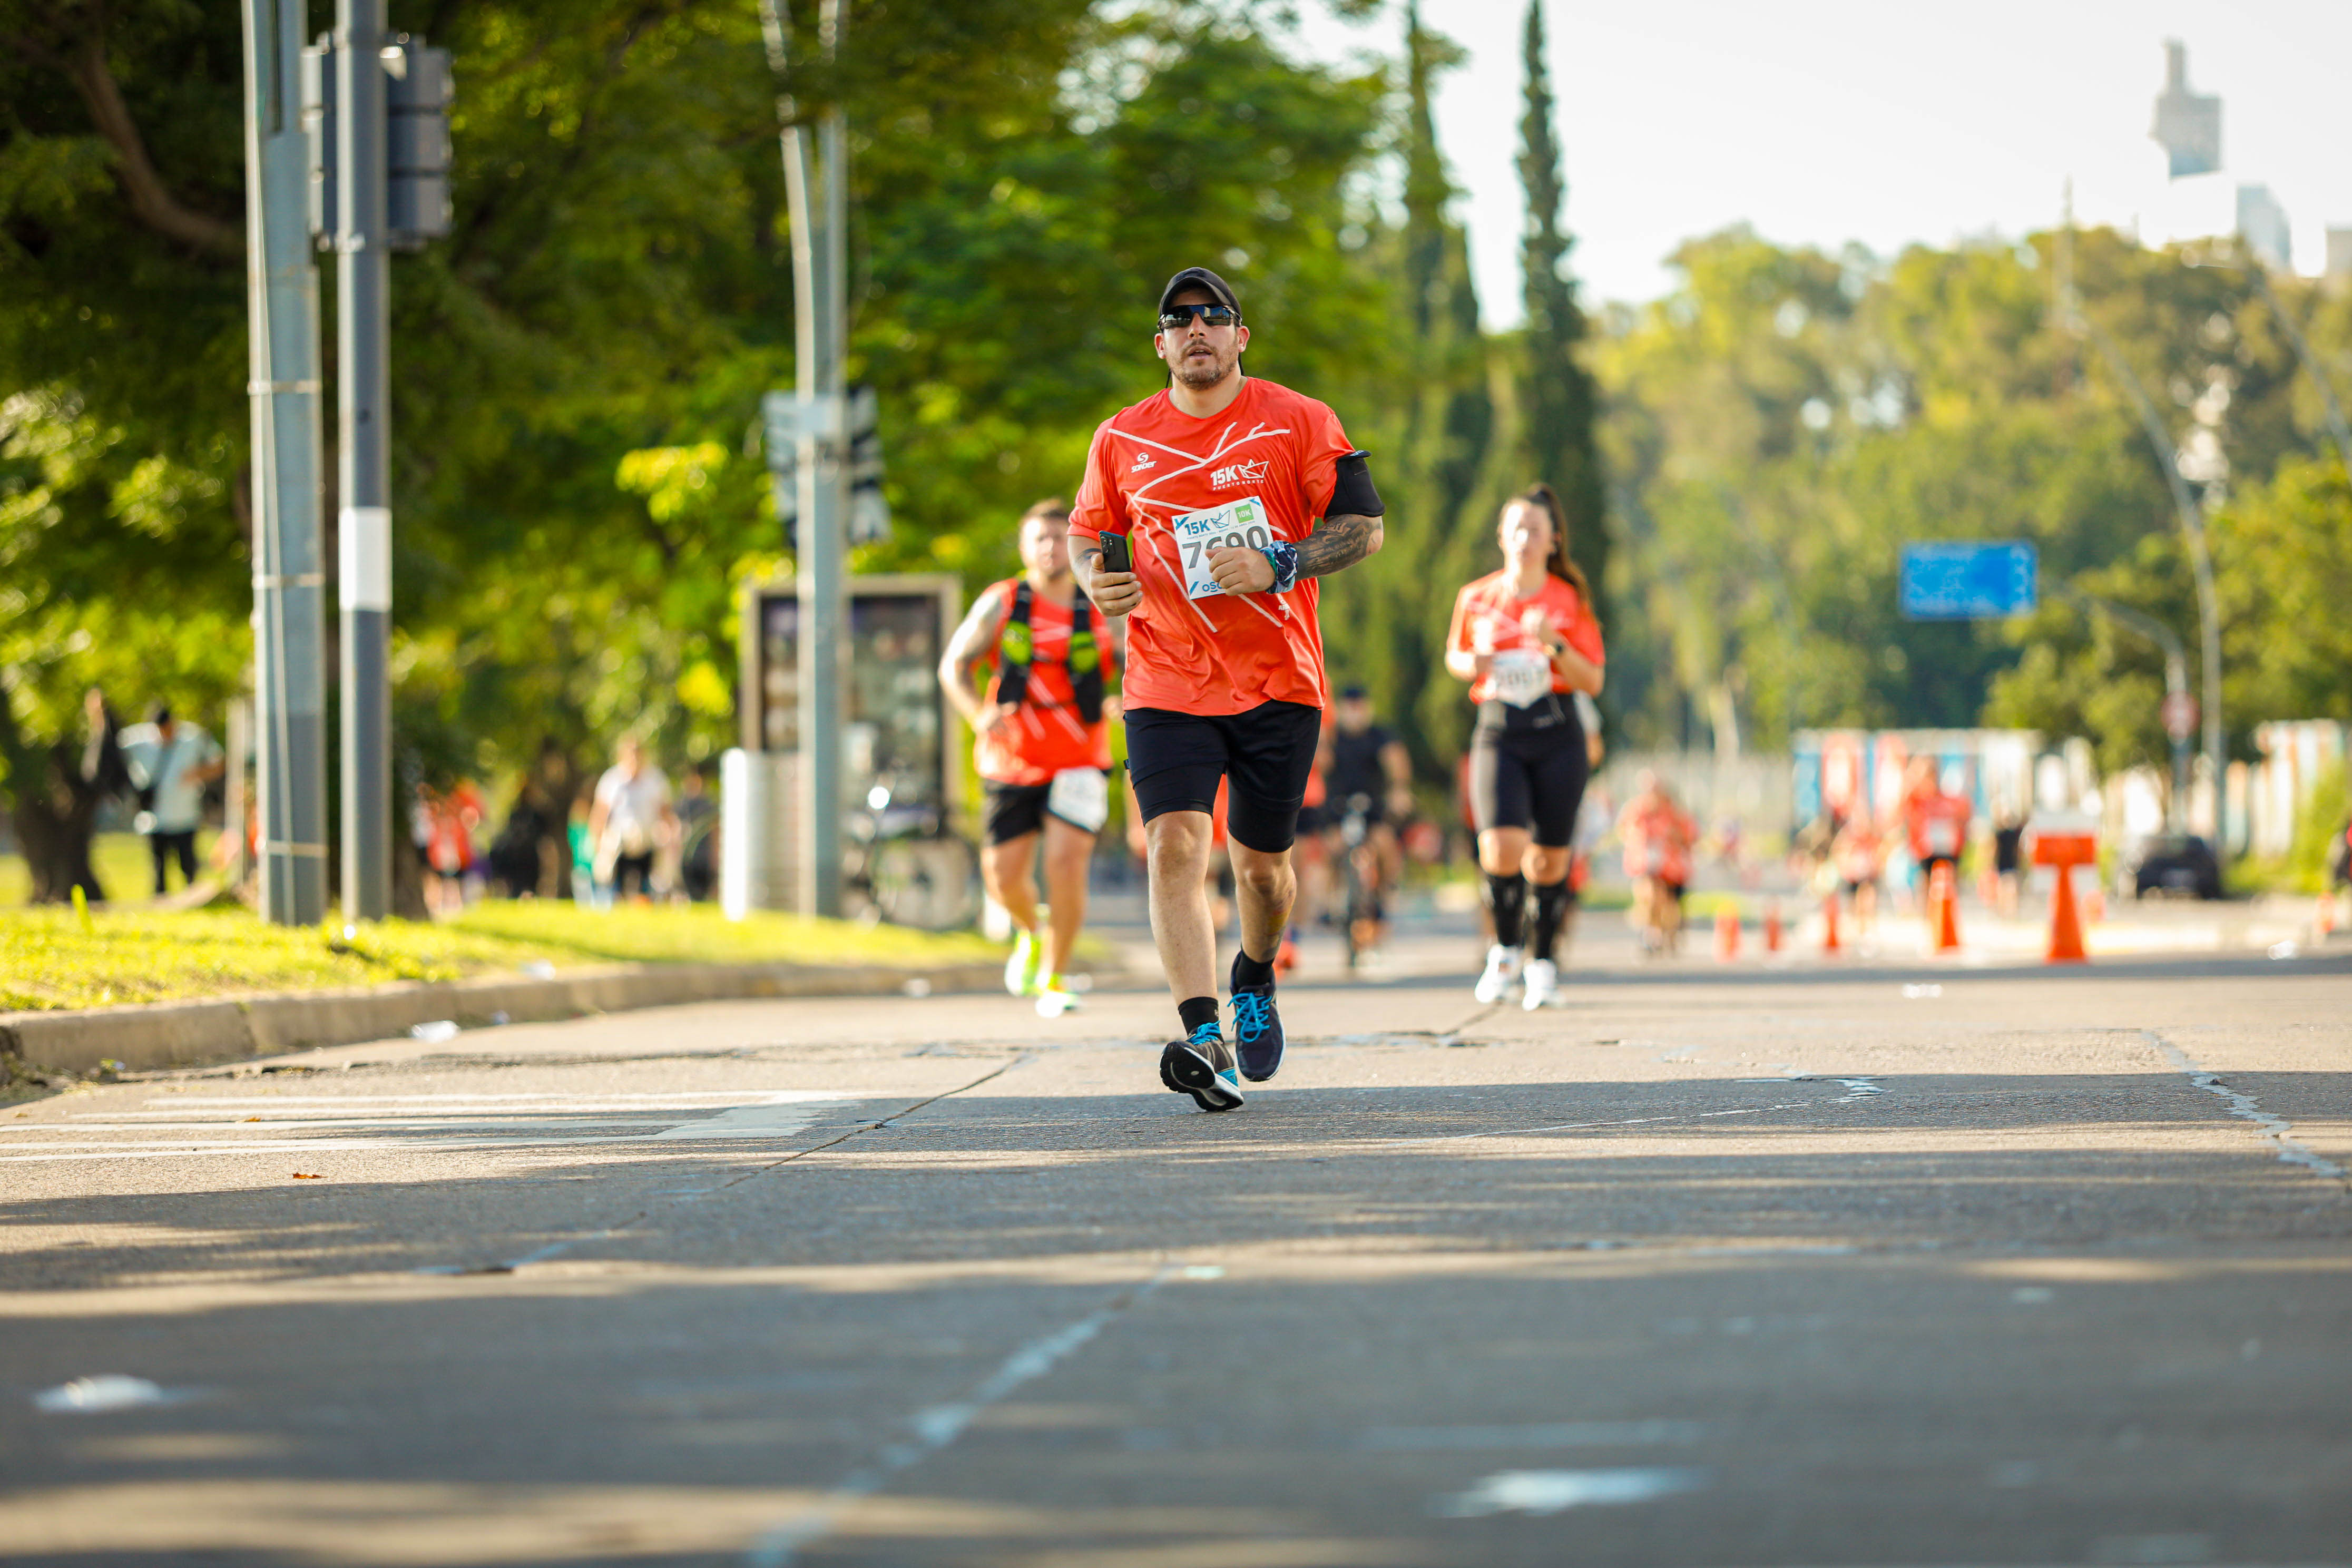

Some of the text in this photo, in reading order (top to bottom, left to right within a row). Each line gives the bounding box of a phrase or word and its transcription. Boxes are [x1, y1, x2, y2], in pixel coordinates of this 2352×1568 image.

[1210, 465, 1239, 486] 15K
[1213, 482, 1240, 491] PUERTO
[1237, 509, 1251, 518] 10K
[1184, 519, 1210, 535] 15K
